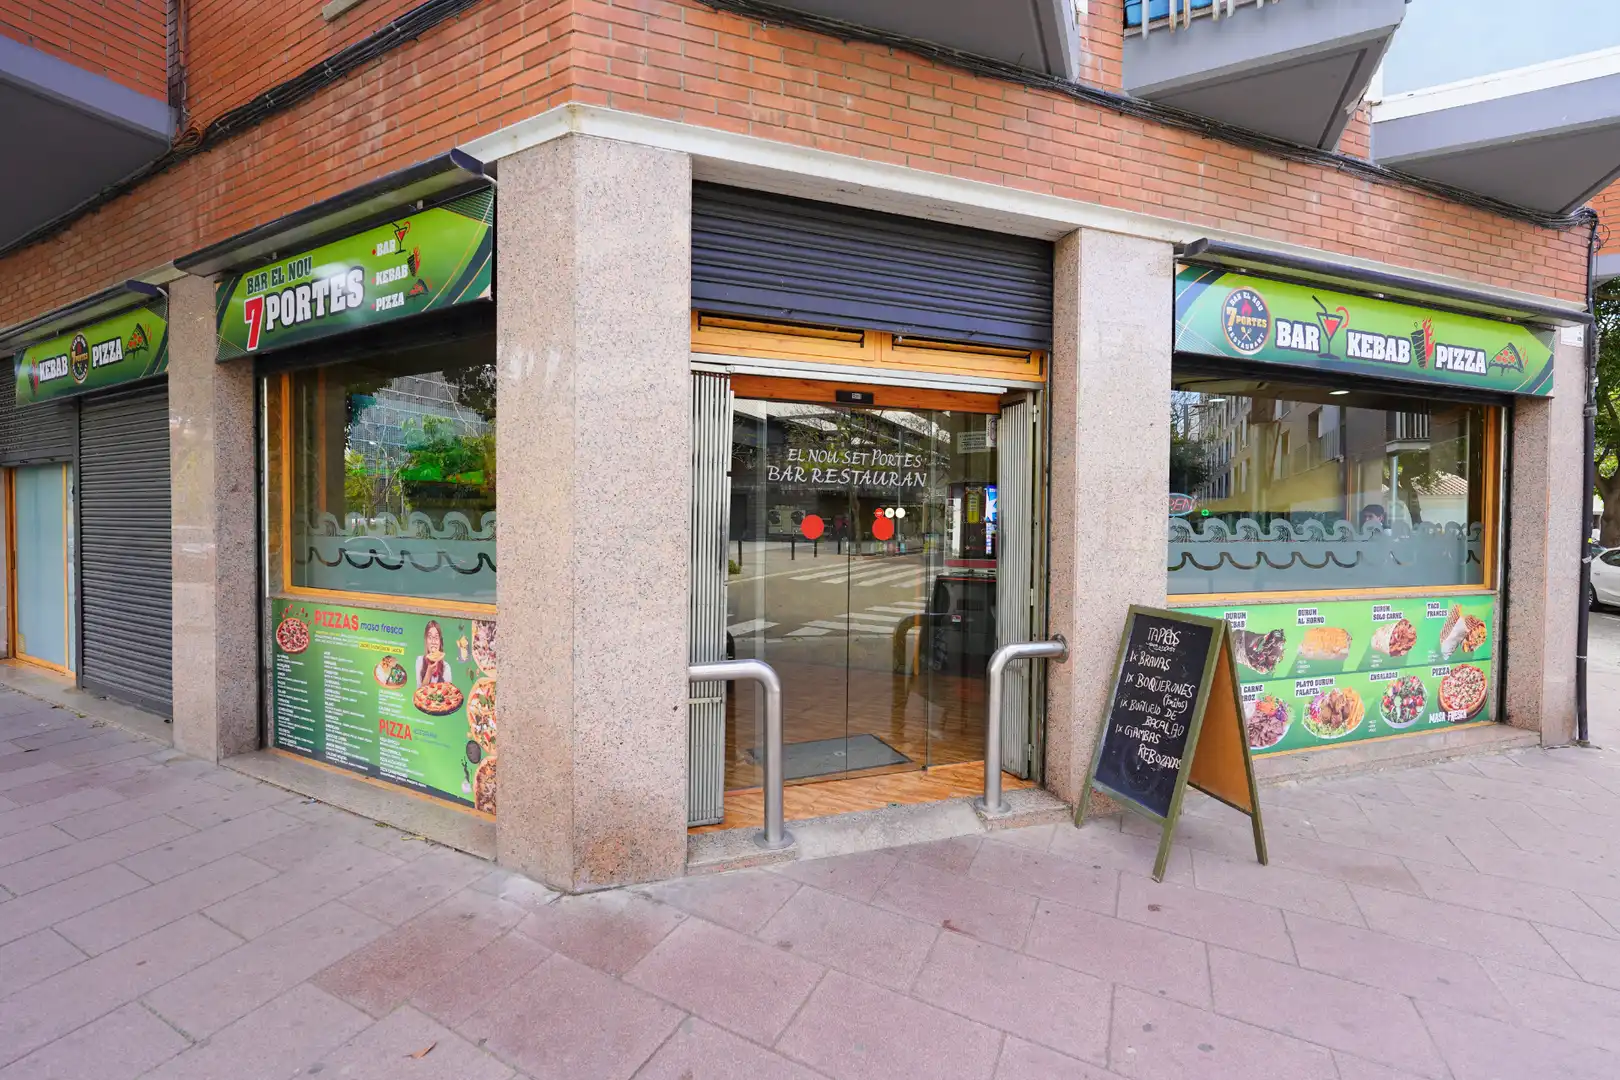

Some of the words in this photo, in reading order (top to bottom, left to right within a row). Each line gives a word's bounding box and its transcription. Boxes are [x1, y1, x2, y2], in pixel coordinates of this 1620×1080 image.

[376, 239, 396, 257] BAR
[247, 272, 268, 295] BAR
[272, 266, 285, 288] EL
[288, 256, 313, 283] NOU
[376, 264, 409, 285] KEBAB
[244, 295, 264, 351] 7
[265, 268, 365, 331] PORTES
[376, 292, 405, 311] PIZZA
[1230, 293, 1242, 306] BAR
[1243, 291, 1251, 300] EL
[1252, 296, 1264, 311] NOU
[1226, 306, 1237, 327] 7
[1236, 315, 1267, 328] PORTES
[1227, 326, 1265, 349] RESTAURANT
[1276, 320, 1320, 352] BAR
[92, 338, 122, 368] PIZZA
[1347, 331, 1411, 364] KEBAB
[40, 355, 68, 381] KEBAB
[1435, 345, 1487, 375] PIZZA
[788, 448, 805, 463] EL
[808, 449, 839, 464] NOU
[842, 450, 869, 466] SET
[872, 448, 922, 468] PORTES
[767, 465, 807, 482] BAR
[811, 466, 927, 487] RESTAURAN
[1169, 497, 1192, 511] PEN
[314, 609, 359, 631] PIZZAS
[1225, 612, 1246, 620] DURUM
[1306, 616, 1325, 624] HORNO
[360, 622, 380, 632] masa
[381, 623, 404, 635] fresca
[1147, 627, 1181, 646] TAPAS
[1138, 650, 1171, 671] BRAVAS
[1370, 672, 1398, 680] ENSALADAS
[1432, 667, 1450, 676] PIZZA
[1135, 672, 1196, 699] BOQUERONES
[1243, 684, 1263, 693] CARNE
[1296, 680, 1314, 688] PLATO
[1315, 678, 1334, 686] DURUM
[1296, 688, 1320, 696] FALAFEL
[1164, 708, 1178, 720] DE
[1428, 711, 1446, 724] MASA
[379, 718, 413, 741] PIZZA
[1124, 725, 1161, 744] GAMBAS
[1142, 715, 1184, 738] BACALAO
